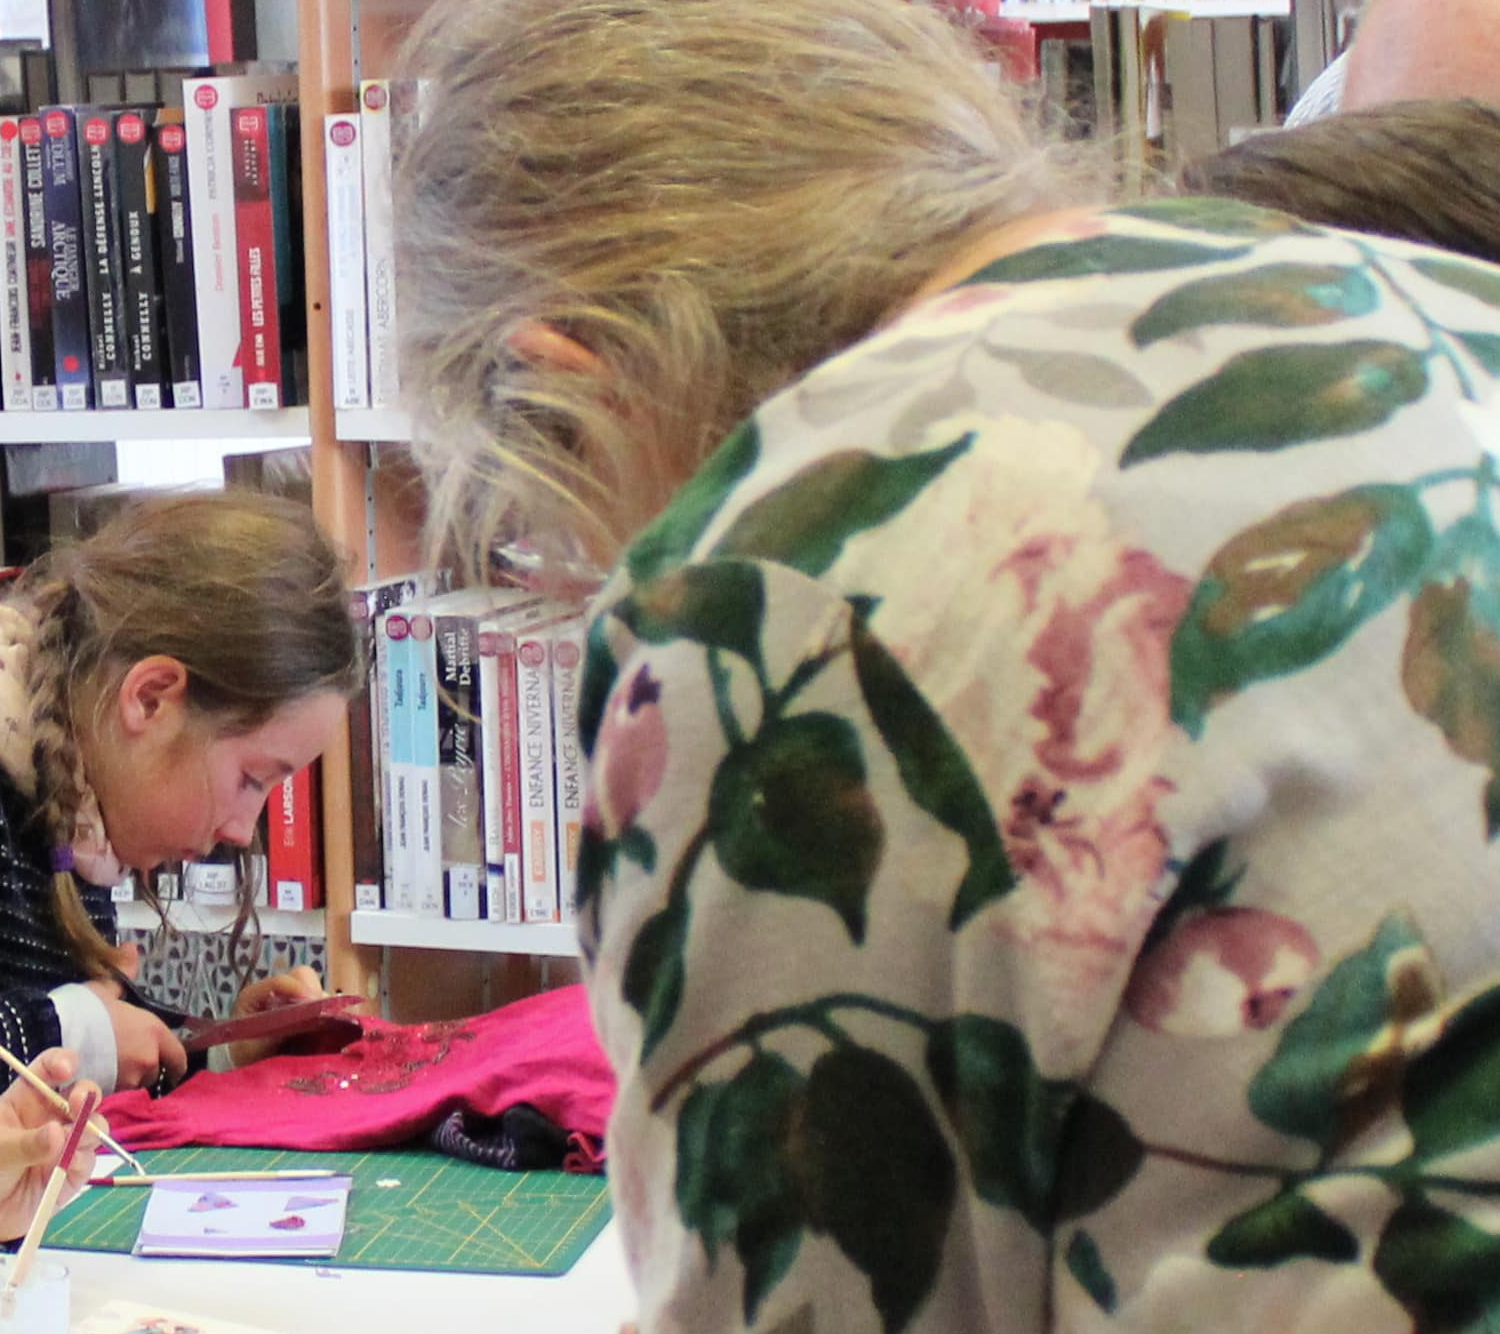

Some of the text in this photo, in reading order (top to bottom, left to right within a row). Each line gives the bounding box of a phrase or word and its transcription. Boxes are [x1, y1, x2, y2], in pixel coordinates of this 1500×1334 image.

[28, 191, 46, 249] SANDRINE
[94, 211, 108, 257] DÉFENSE
[128, 210, 142, 260] GENOUX
[51, 220, 71, 301] ARCTIQUE
[99, 258, 109, 274] LA
[102, 292, 116, 361] CONNELLY
[138, 292, 152, 361] CONNELLY
[445, 632, 457, 681] Martial
[524, 670, 542, 736] NIVERNA
[560, 670, 579, 810] ENFANCE NIVERNA
[526, 742, 545, 808] ENFANCE
